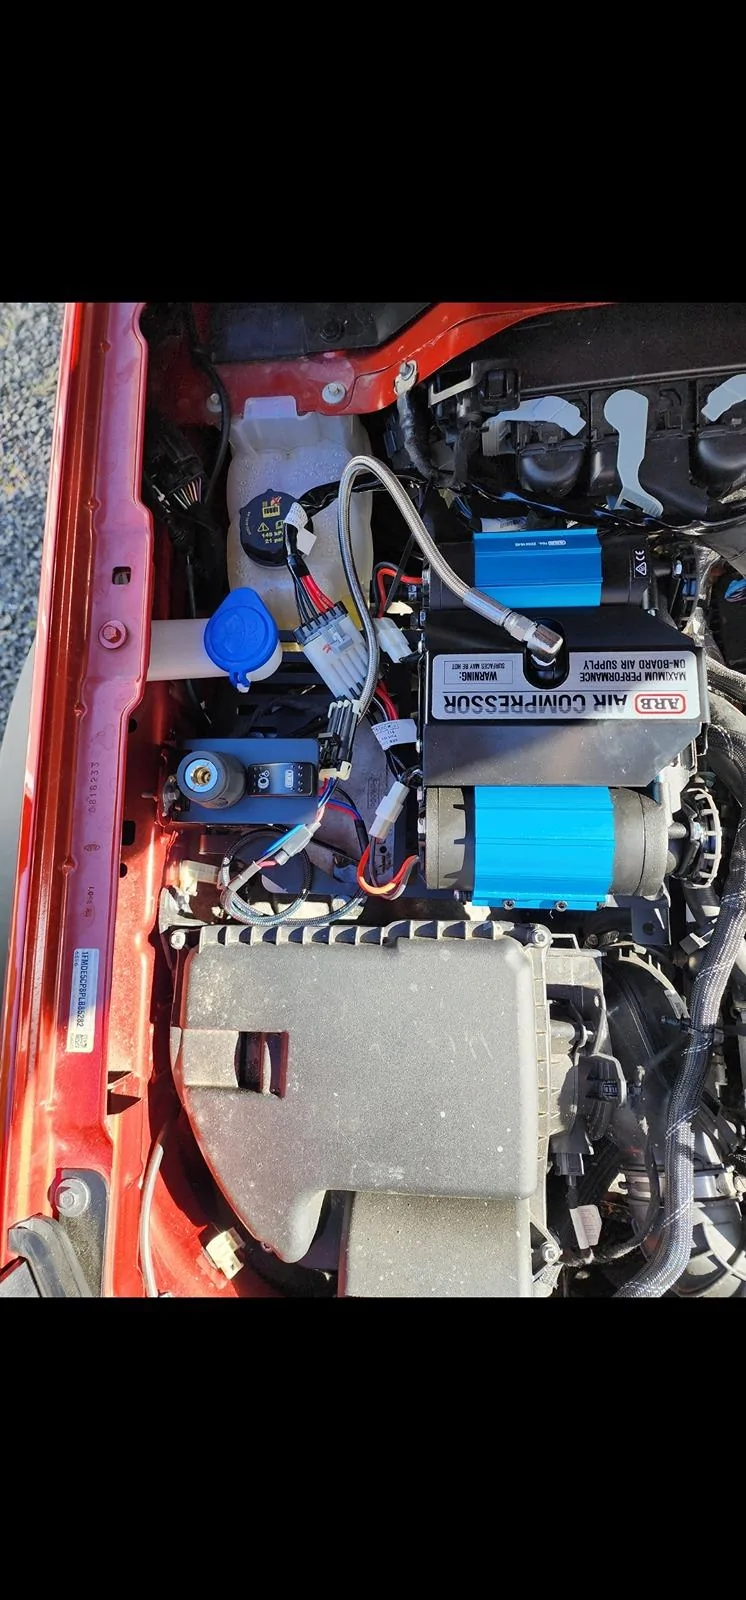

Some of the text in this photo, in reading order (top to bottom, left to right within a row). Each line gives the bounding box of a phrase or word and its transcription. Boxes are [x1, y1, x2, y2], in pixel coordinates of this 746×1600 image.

[583, 659, 686, 670] ON-BOARD AIR SUPPLY
[459, 671, 498, 681] WARNING:
[580, 671, 687, 682] MAXIMUM PERFORMANCE
[443, 694, 680, 715] ARB AIR COMPRESSOR
